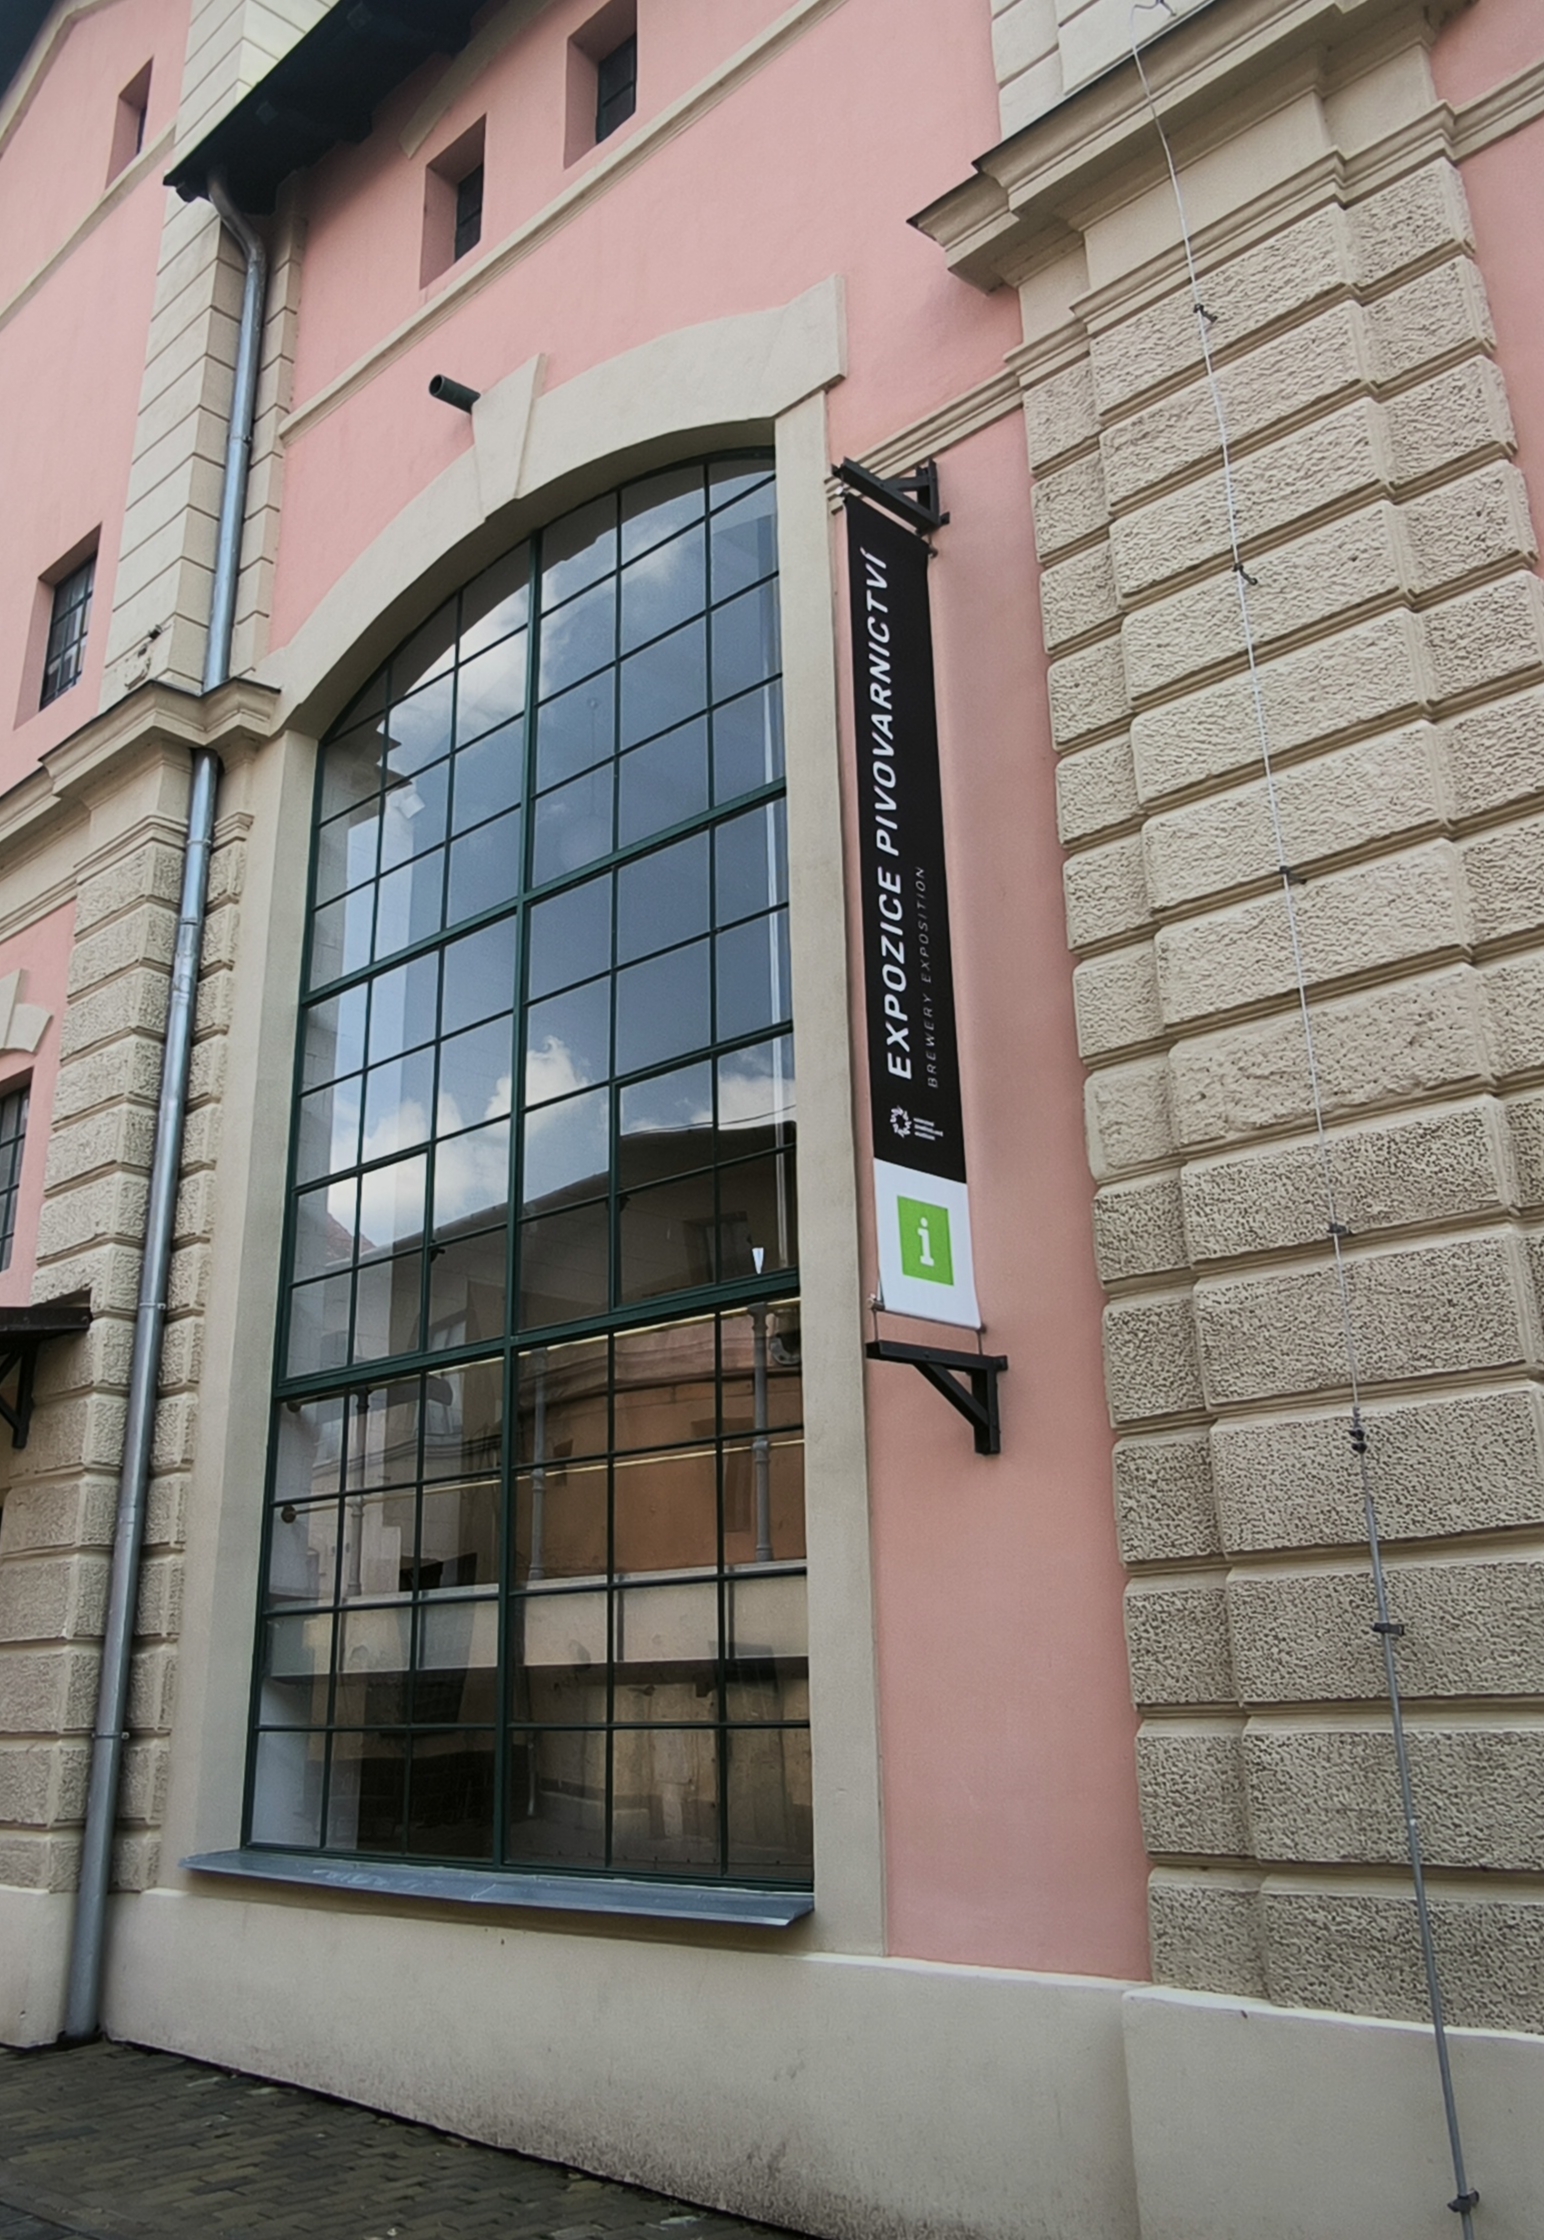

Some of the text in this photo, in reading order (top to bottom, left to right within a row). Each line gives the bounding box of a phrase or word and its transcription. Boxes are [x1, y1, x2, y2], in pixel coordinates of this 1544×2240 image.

[860, 547, 912, 1080] EXPOZICE PIVOVARNICTVÍ
[915, 866, 938, 1088] BREWERY EXPOSITION
